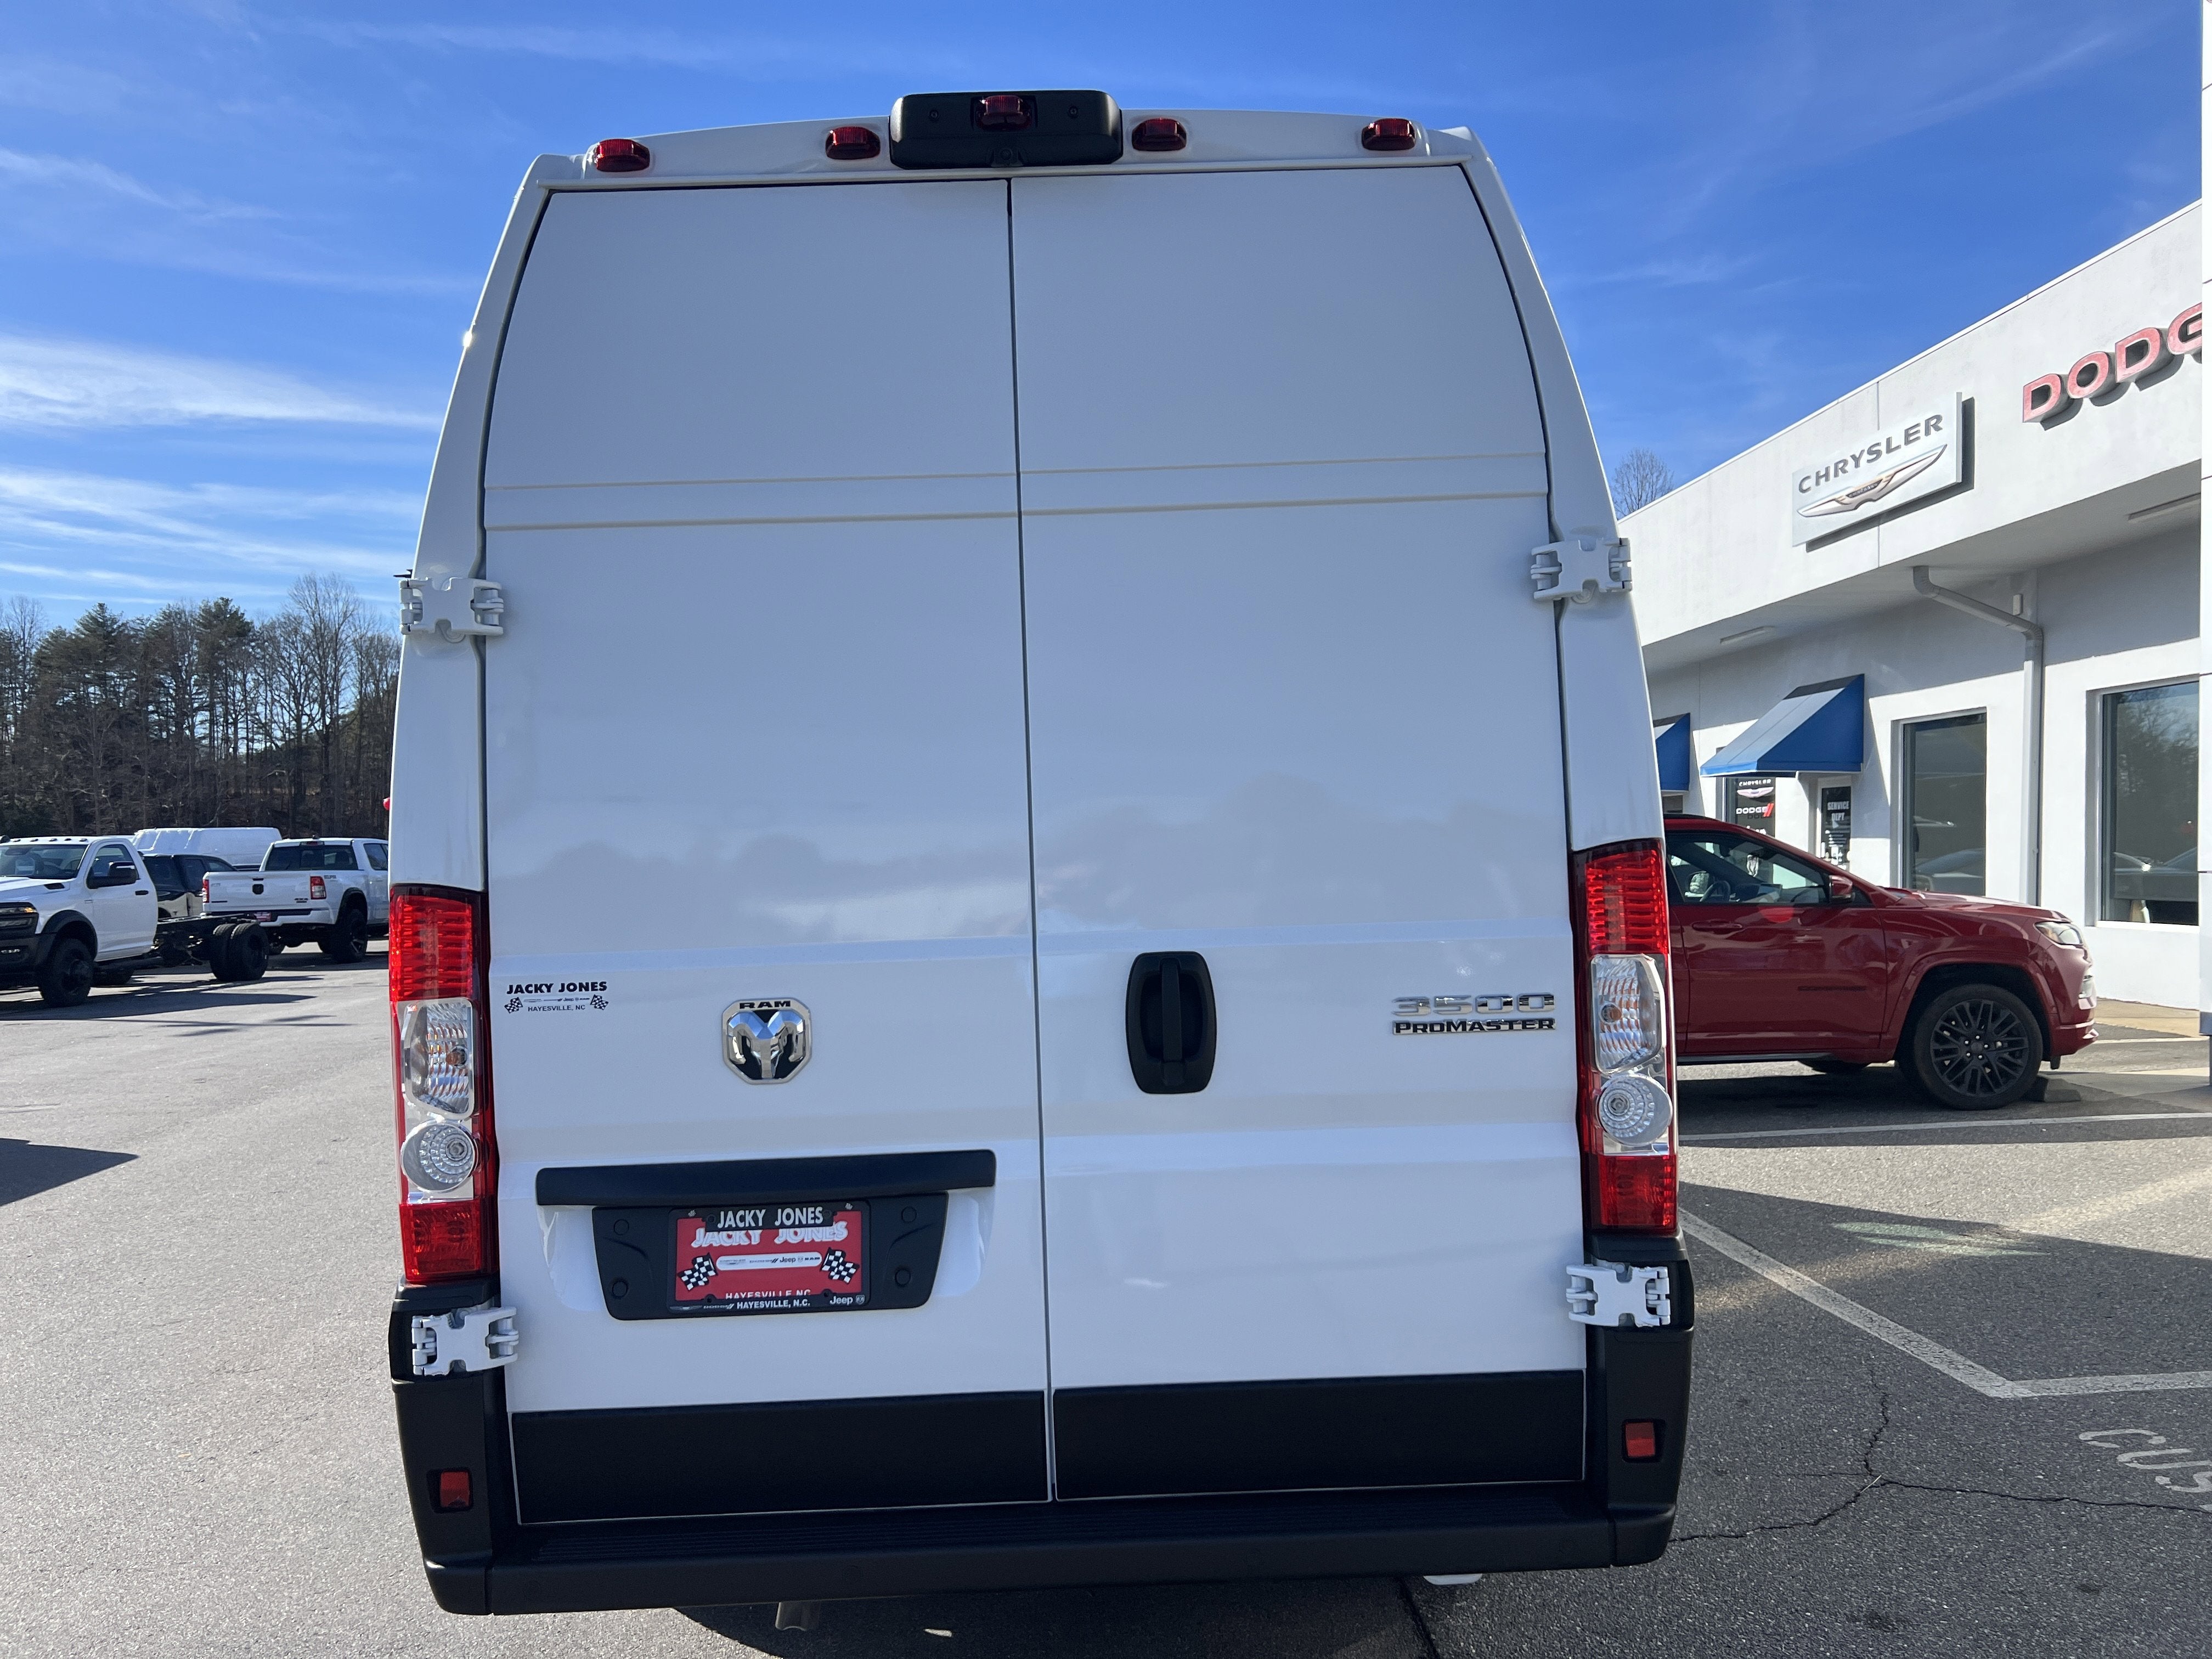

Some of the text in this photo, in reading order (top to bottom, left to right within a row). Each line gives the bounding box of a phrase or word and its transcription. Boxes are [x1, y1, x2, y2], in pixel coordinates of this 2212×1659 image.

[1798, 414, 1943, 493] CHRYSLER
[1736, 806, 1769, 815] DODGE
[1827, 801, 1849, 810] SERVICE
[1831, 812, 1845, 821] DEPT
[506, 981, 607, 994] JACKY JONES
[740, 1001, 791, 1009] RAM
[1392, 992, 1555, 1015] 3500
[718, 1206, 823, 1228] JACKY JONES
[691, 1221, 848, 1247] JACKY JONES
[737, 1300, 791, 1309] HAYESVILLE,
[793, 1299, 810, 1307] N.C.
[830, 1295, 853, 1306] Jeep
